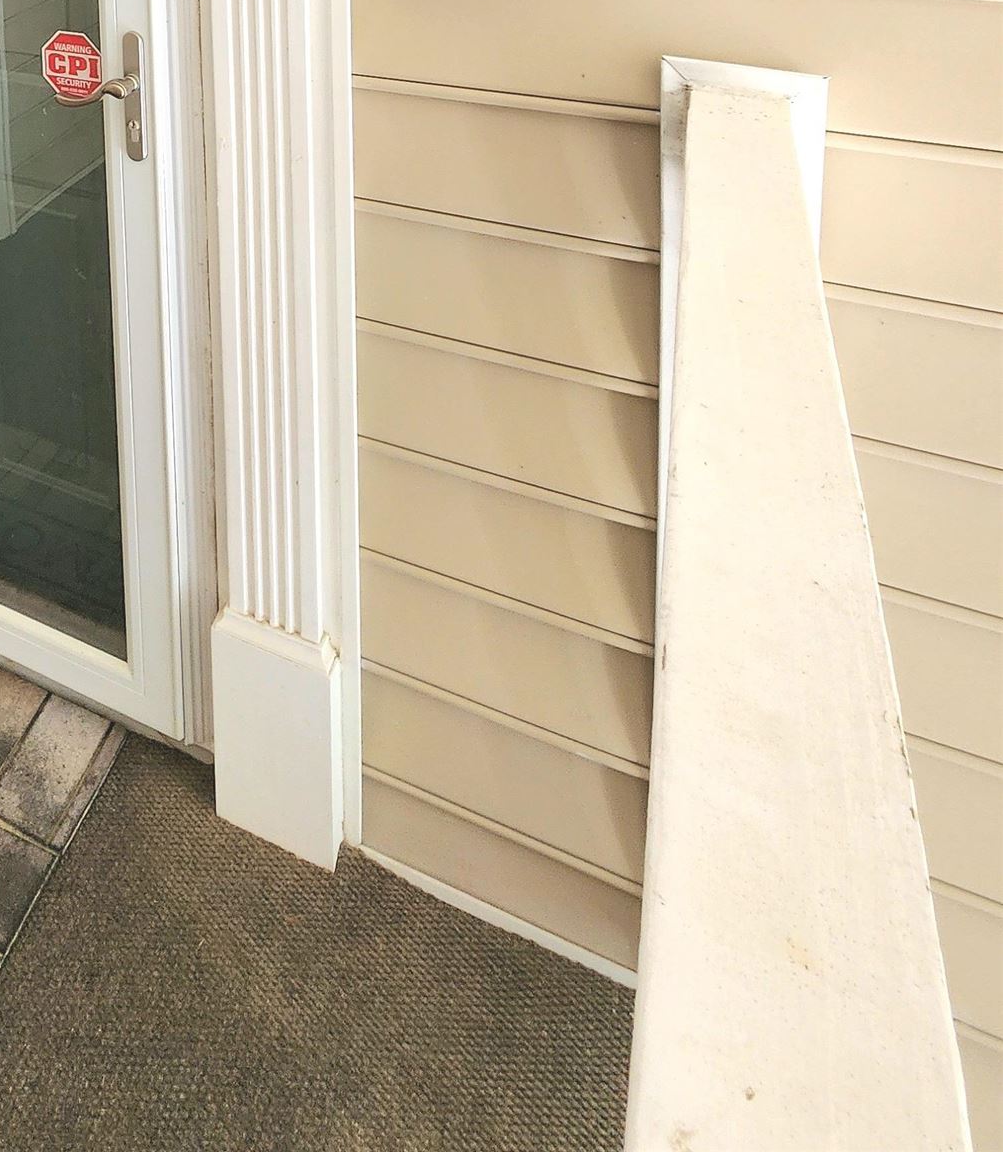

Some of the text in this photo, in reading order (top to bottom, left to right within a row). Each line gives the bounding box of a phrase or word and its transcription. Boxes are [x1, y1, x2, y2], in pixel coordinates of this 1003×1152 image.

[53, 42, 92, 55] WARNING
[48, 53, 99, 79] CPI
[56, 77, 92, 89] SECURITY
